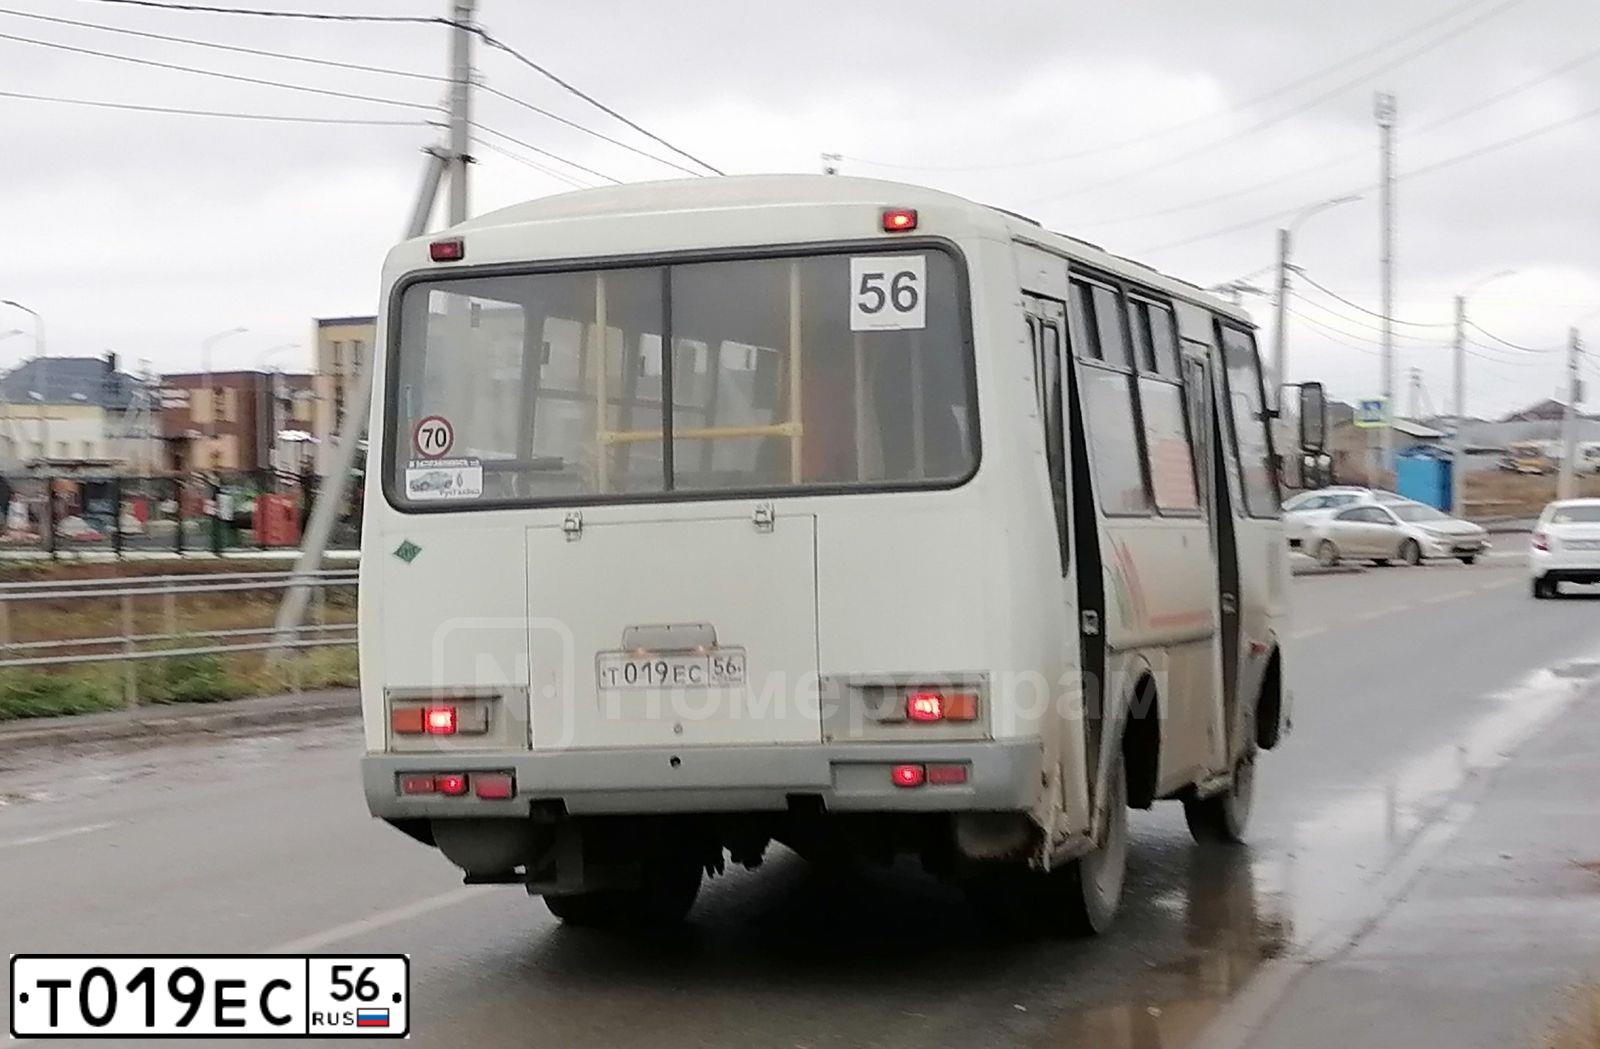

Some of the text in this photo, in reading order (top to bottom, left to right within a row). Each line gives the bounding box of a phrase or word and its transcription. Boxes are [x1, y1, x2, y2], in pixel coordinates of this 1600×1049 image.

[858, 270, 919, 314] 56
[422, 427, 447, 449] 70
[713, 656, 737, 675] 56
